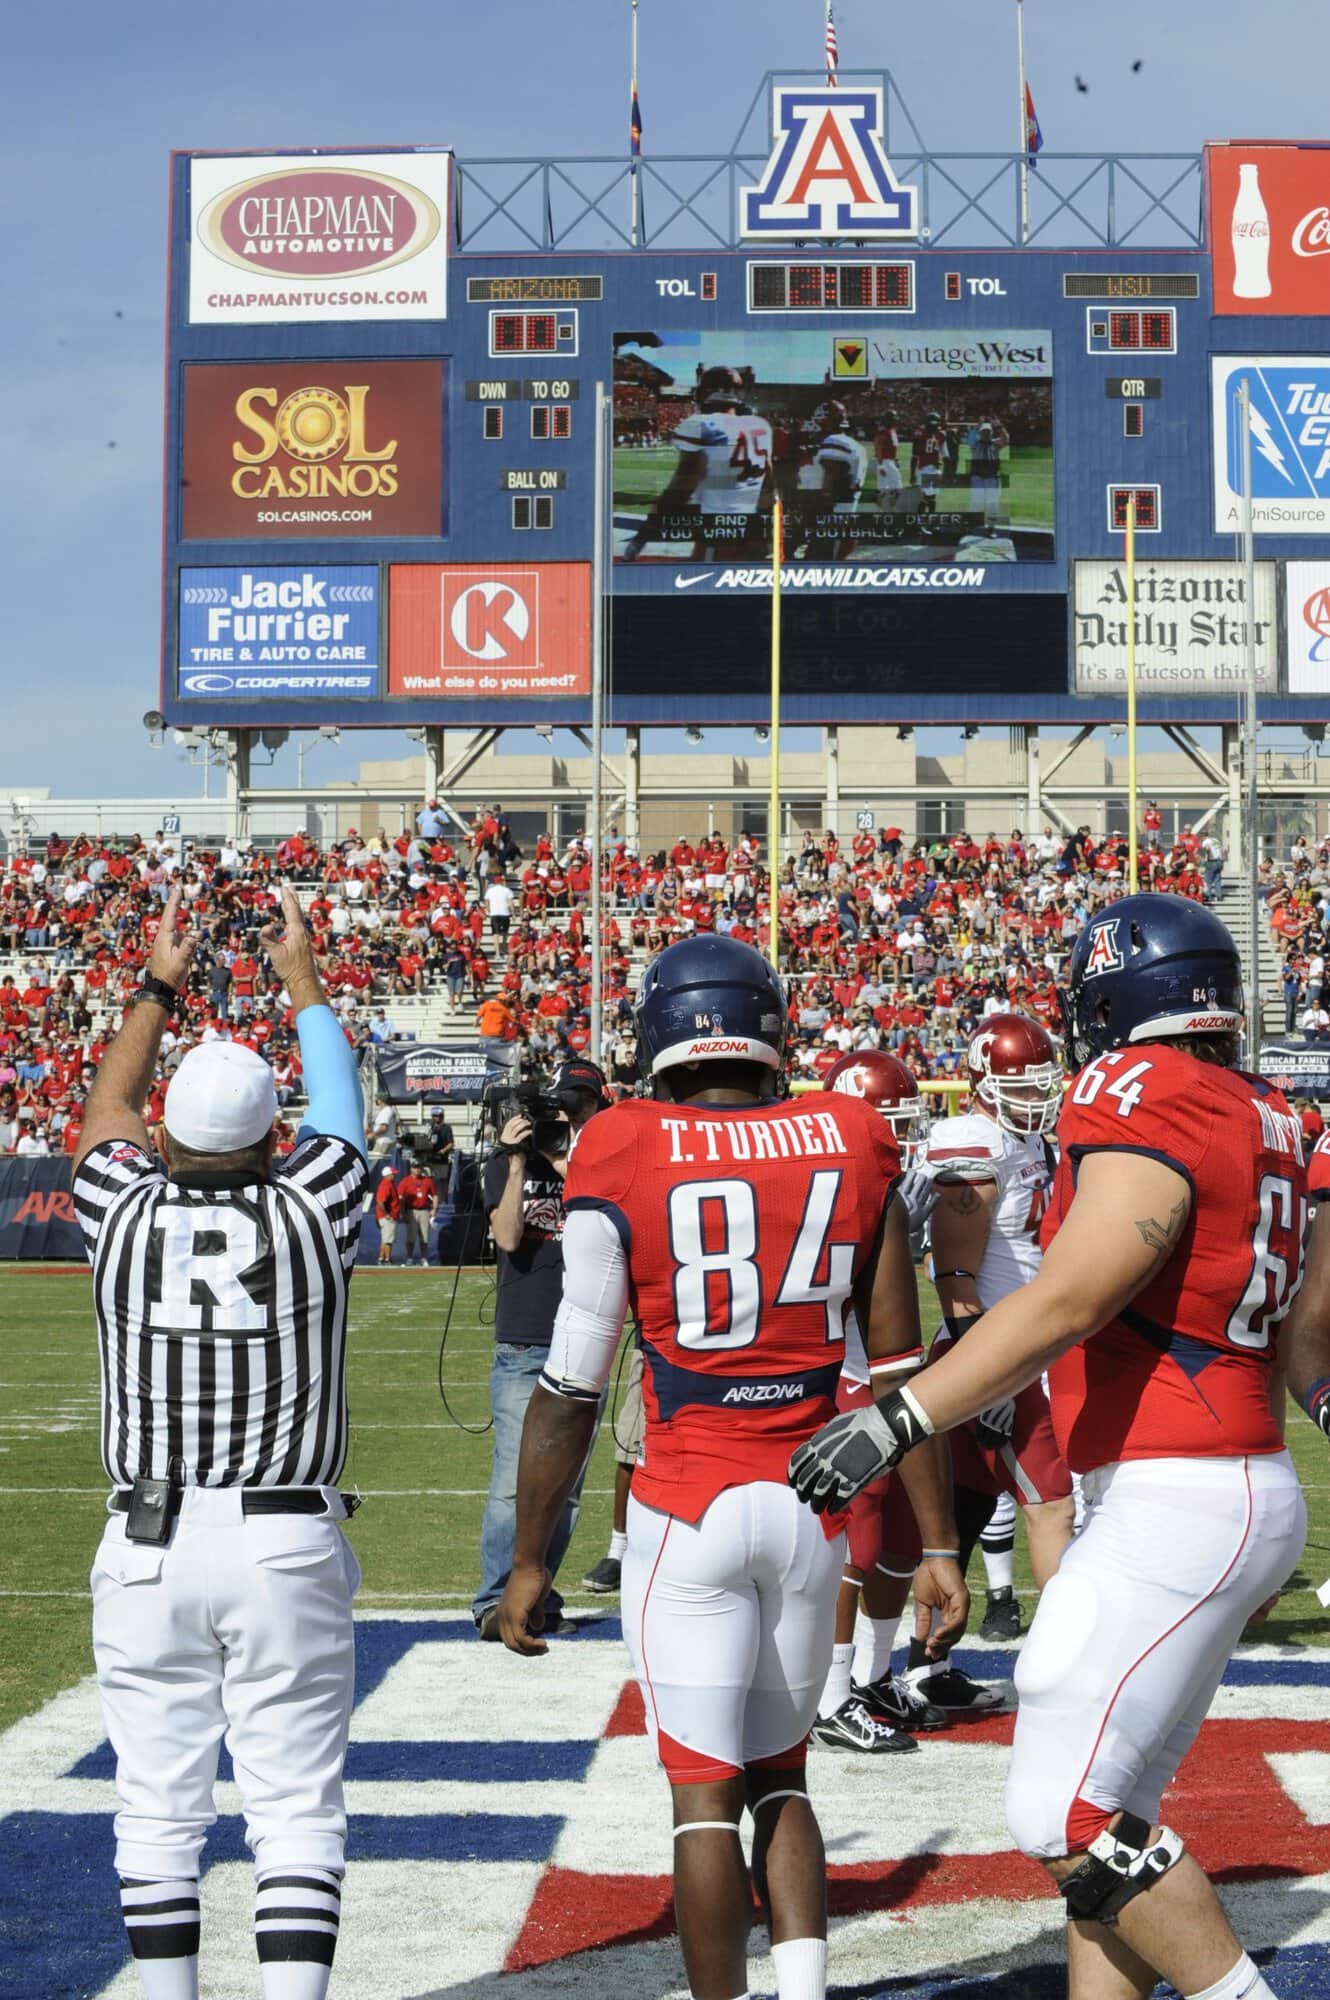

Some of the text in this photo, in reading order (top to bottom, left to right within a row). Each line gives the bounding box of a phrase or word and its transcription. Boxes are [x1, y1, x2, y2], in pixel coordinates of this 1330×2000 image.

[239, 195, 398, 238] CHAPMAN
[243, 238, 394, 254] AUTOMOTIVE
[489, 279, 580, 299] ARIZONA
[656, 279, 696, 297] TOL
[966, 278, 1006, 296] TOL
[1107, 278, 1152, 297] WSU
[207, 290, 429, 308] CHAPMANTUCSON.COM
[479, 382, 506, 399] DWN
[532, 381, 570, 398] TO GO
[1121, 380, 1145, 397] QTR
[232, 385, 398, 464] SOL
[231, 464, 399, 499] CASINOS
[508, 471, 557, 488] BALL ON
[257, 510, 372, 522] SOLCASINOS.COM
[715, 514, 748, 526] AND
[1227, 506, 1240, 520] A
[704, 528, 746, 539] WANT
[231, 573, 328, 609] Jack
[1096, 567, 1248, 604] Arizona
[207, 607, 350, 642] Furrier
[1075, 611, 1178, 656] Daily
[1188, 611, 1271, 647] Star
[191, 646, 366, 661] TIRE & AUTO CARE
[1078, 664, 1108, 681] It's
[1115, 668, 1128, 681] a
[1135, 663, 1206, 681] Tucson
[403, 674, 577, 690] What else do you need?
[164, 817, 180, 832] 27
[858, 813, 873, 829] 28
[1192, 988, 1207, 1002] 64
[694, 1013, 710, 1029] 84
[1184, 1016, 1236, 1030] ARIZONA
[688, 1041, 749, 1056] ARIZONA
[407, 1058, 487, 1066] AMERICAN FAMILY
[1072, 1053, 1154, 1118] 64
[149, 1205, 269, 1331] R
[667, 1168, 857, 1352] 84
[722, 1383, 804, 1402] ARIZONA
